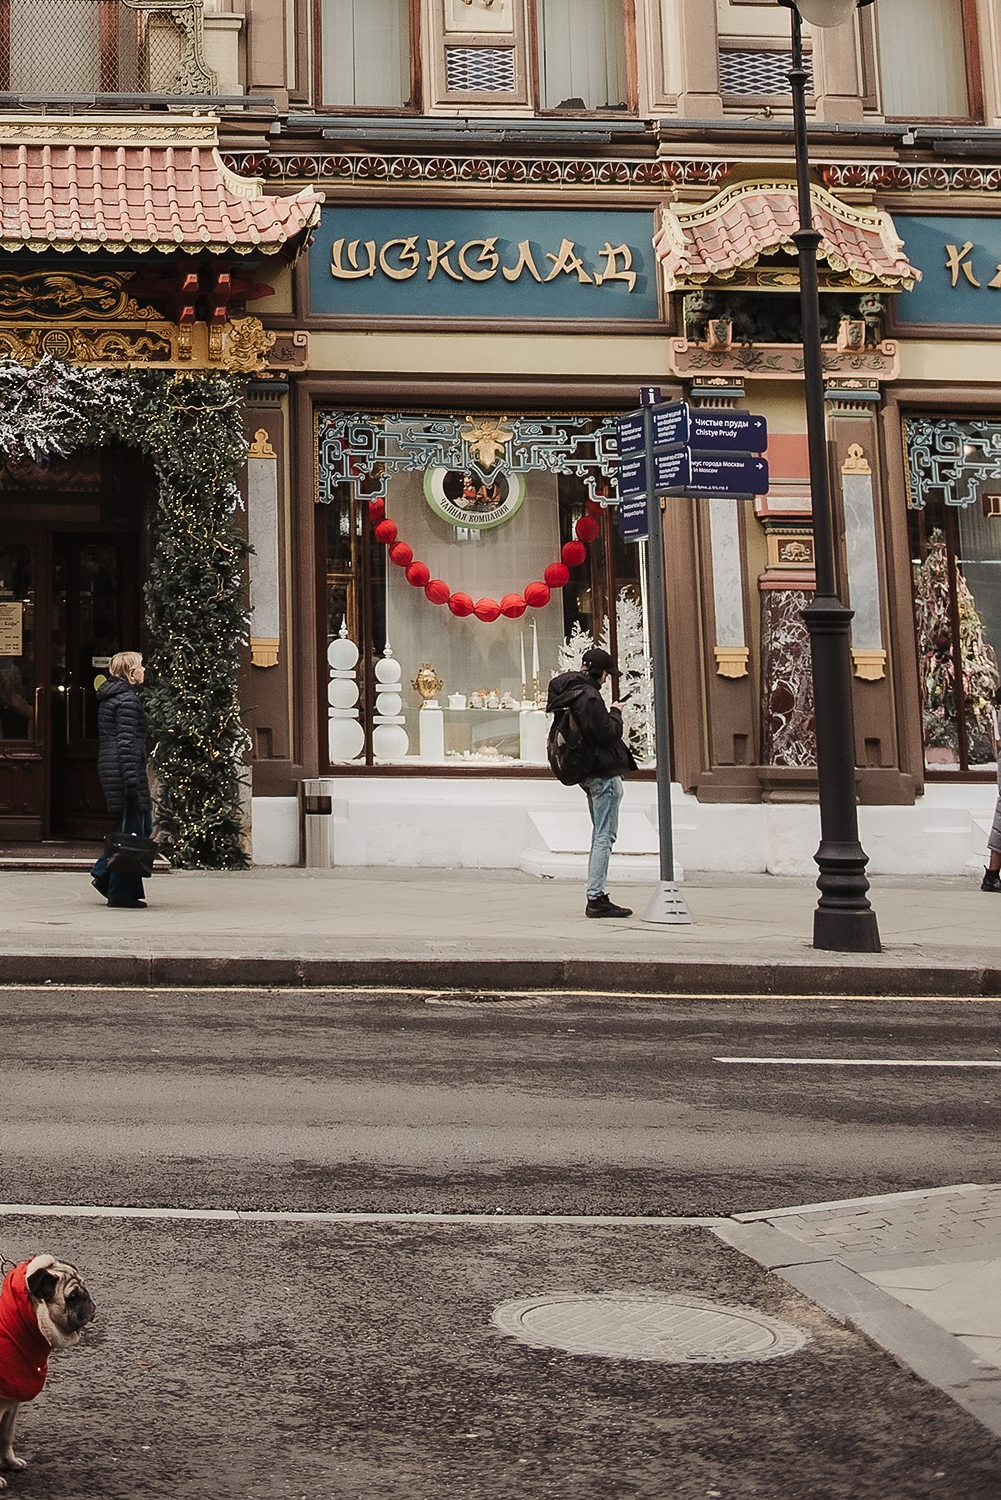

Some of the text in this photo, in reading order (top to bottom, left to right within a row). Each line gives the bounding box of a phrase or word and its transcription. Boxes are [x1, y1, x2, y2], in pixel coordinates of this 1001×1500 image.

[331, 235, 637, 293] ШОКОЛАД
[945, 241, 1001, 287] К
[695, 418, 749, 429] Чистые пруды
[695, 429, 737, 438] Chistye Prudy
[468, 504, 510, 523] КОМПАНИЯ
